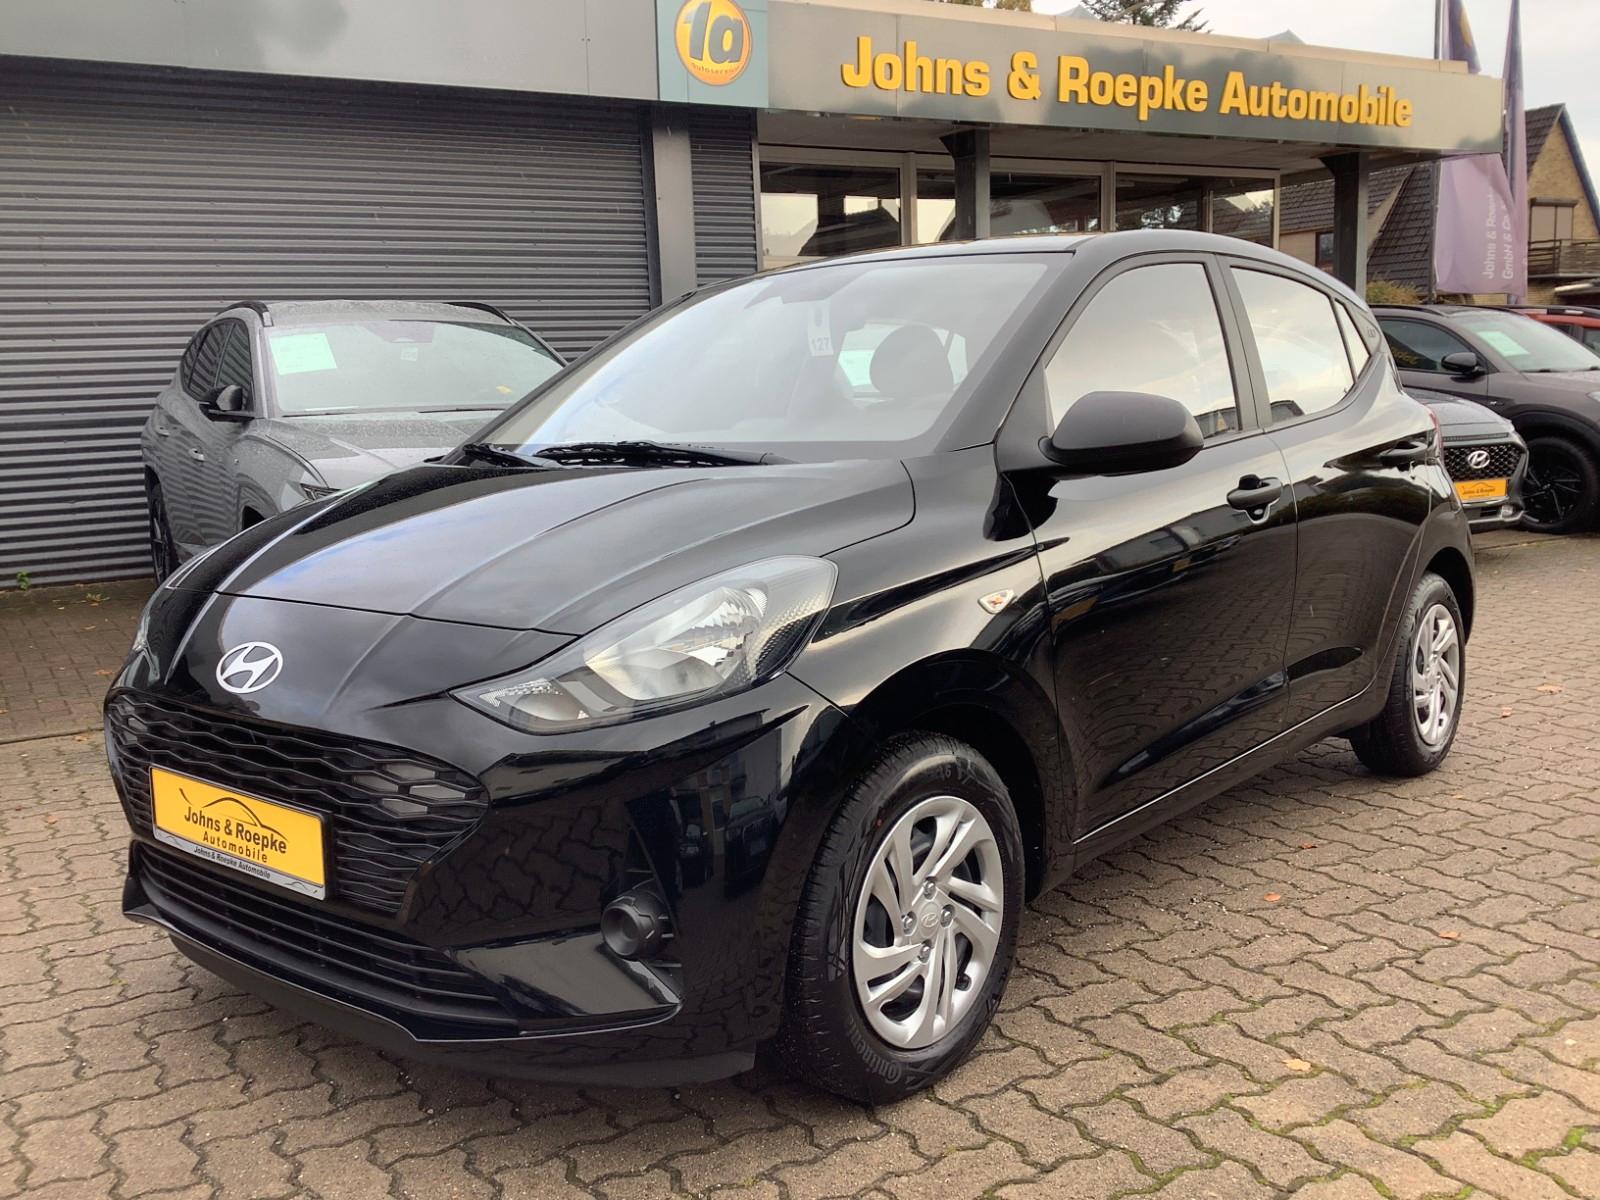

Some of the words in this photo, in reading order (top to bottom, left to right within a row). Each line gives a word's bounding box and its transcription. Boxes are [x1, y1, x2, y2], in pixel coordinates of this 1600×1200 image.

[683, 1, 744, 64] 1a
[841, 36, 991, 97] Johns
[1007, 51, 1042, 100] &
[1057, 55, 1209, 121] Roepke
[1219, 71, 1414, 127] Automobile
[1485, 230, 1497, 240] &
[1502, 233, 1513, 242] &
[1481, 243, 1497, 280] Johns
[1502, 244, 1514, 280] GmbH
[811, 336, 830, 351] 127
[184, 806, 221, 832] Johns
[224, 819, 234, 836] &
[235, 823, 288, 854] Roepke
[203, 831, 269, 863] Automobile
[194, 846, 210, 858] Johns
[238, 861, 271, 879] Automobile
